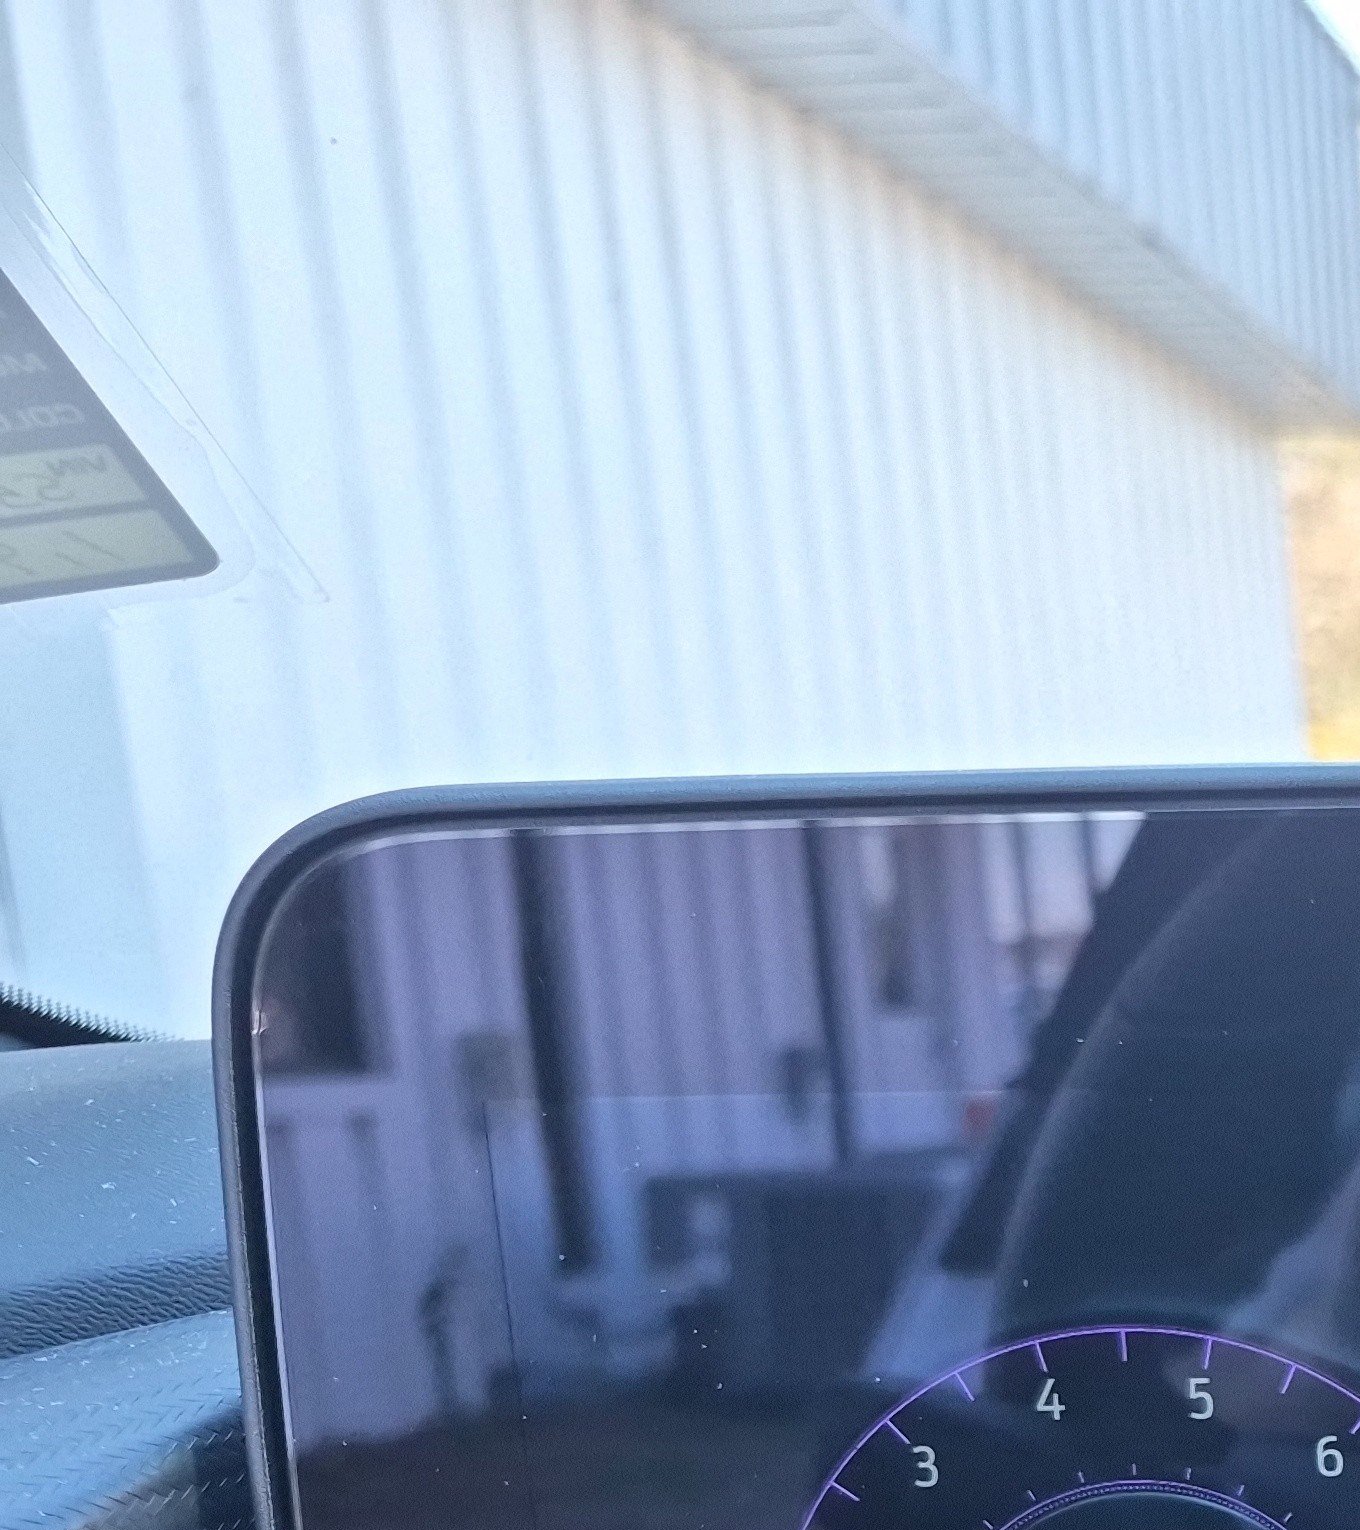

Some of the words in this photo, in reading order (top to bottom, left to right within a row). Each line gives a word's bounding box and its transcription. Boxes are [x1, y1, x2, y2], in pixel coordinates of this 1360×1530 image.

[1035, 1378, 1066, 1421] 4
[1188, 1377, 1214, 1420] 5
[912, 1445, 939, 1488] 3
[1315, 1435, 1344, 1477] 6
